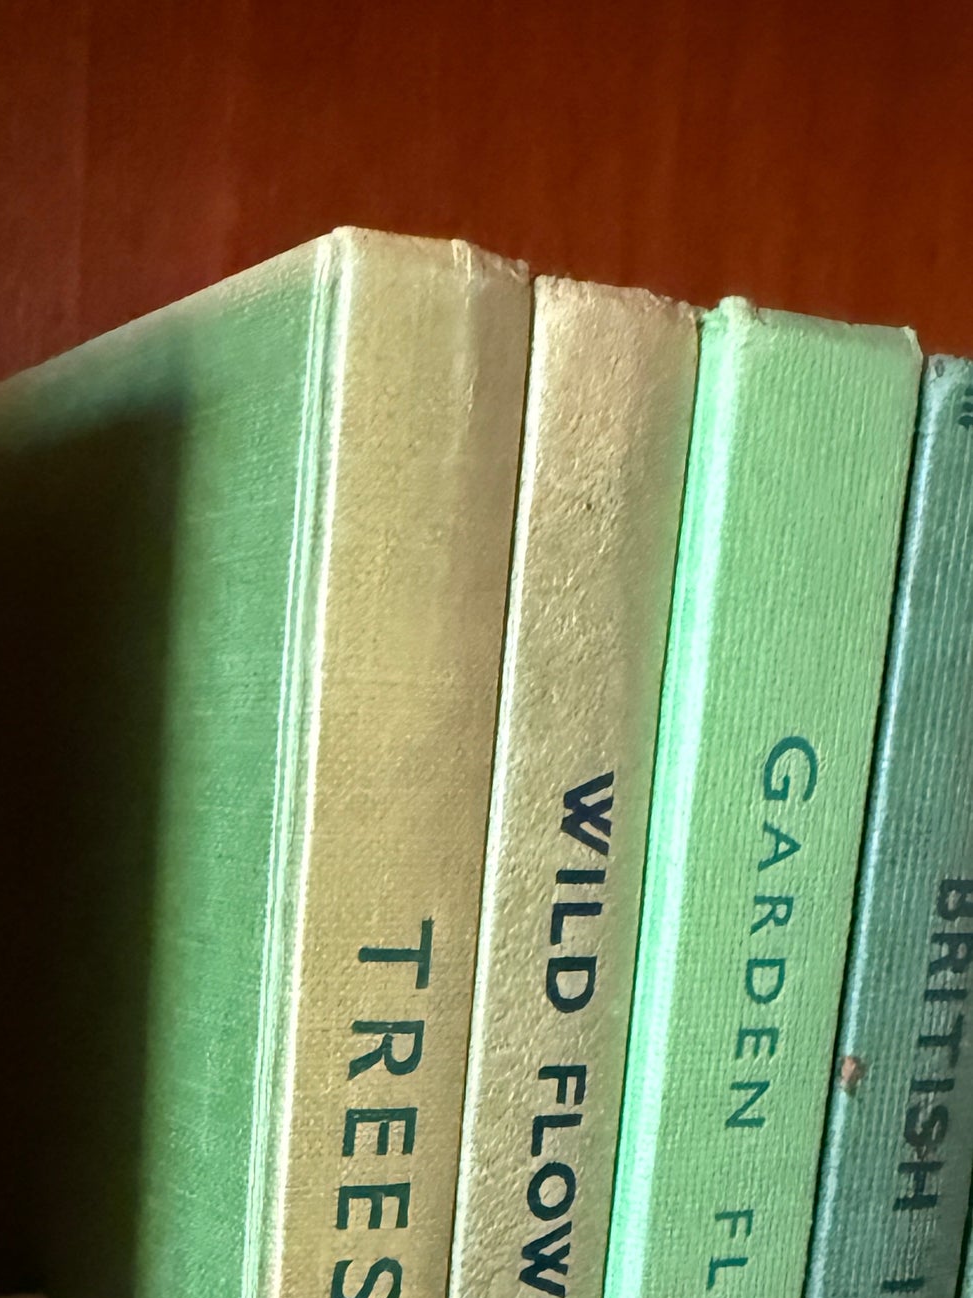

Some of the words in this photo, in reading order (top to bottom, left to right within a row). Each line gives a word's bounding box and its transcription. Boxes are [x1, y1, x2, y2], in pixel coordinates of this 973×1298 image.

[544, 772, 615, 1015] WILD
[724, 735, 819, 1131] GARDEN
[894, 876, 973, 1213] BRITISH
